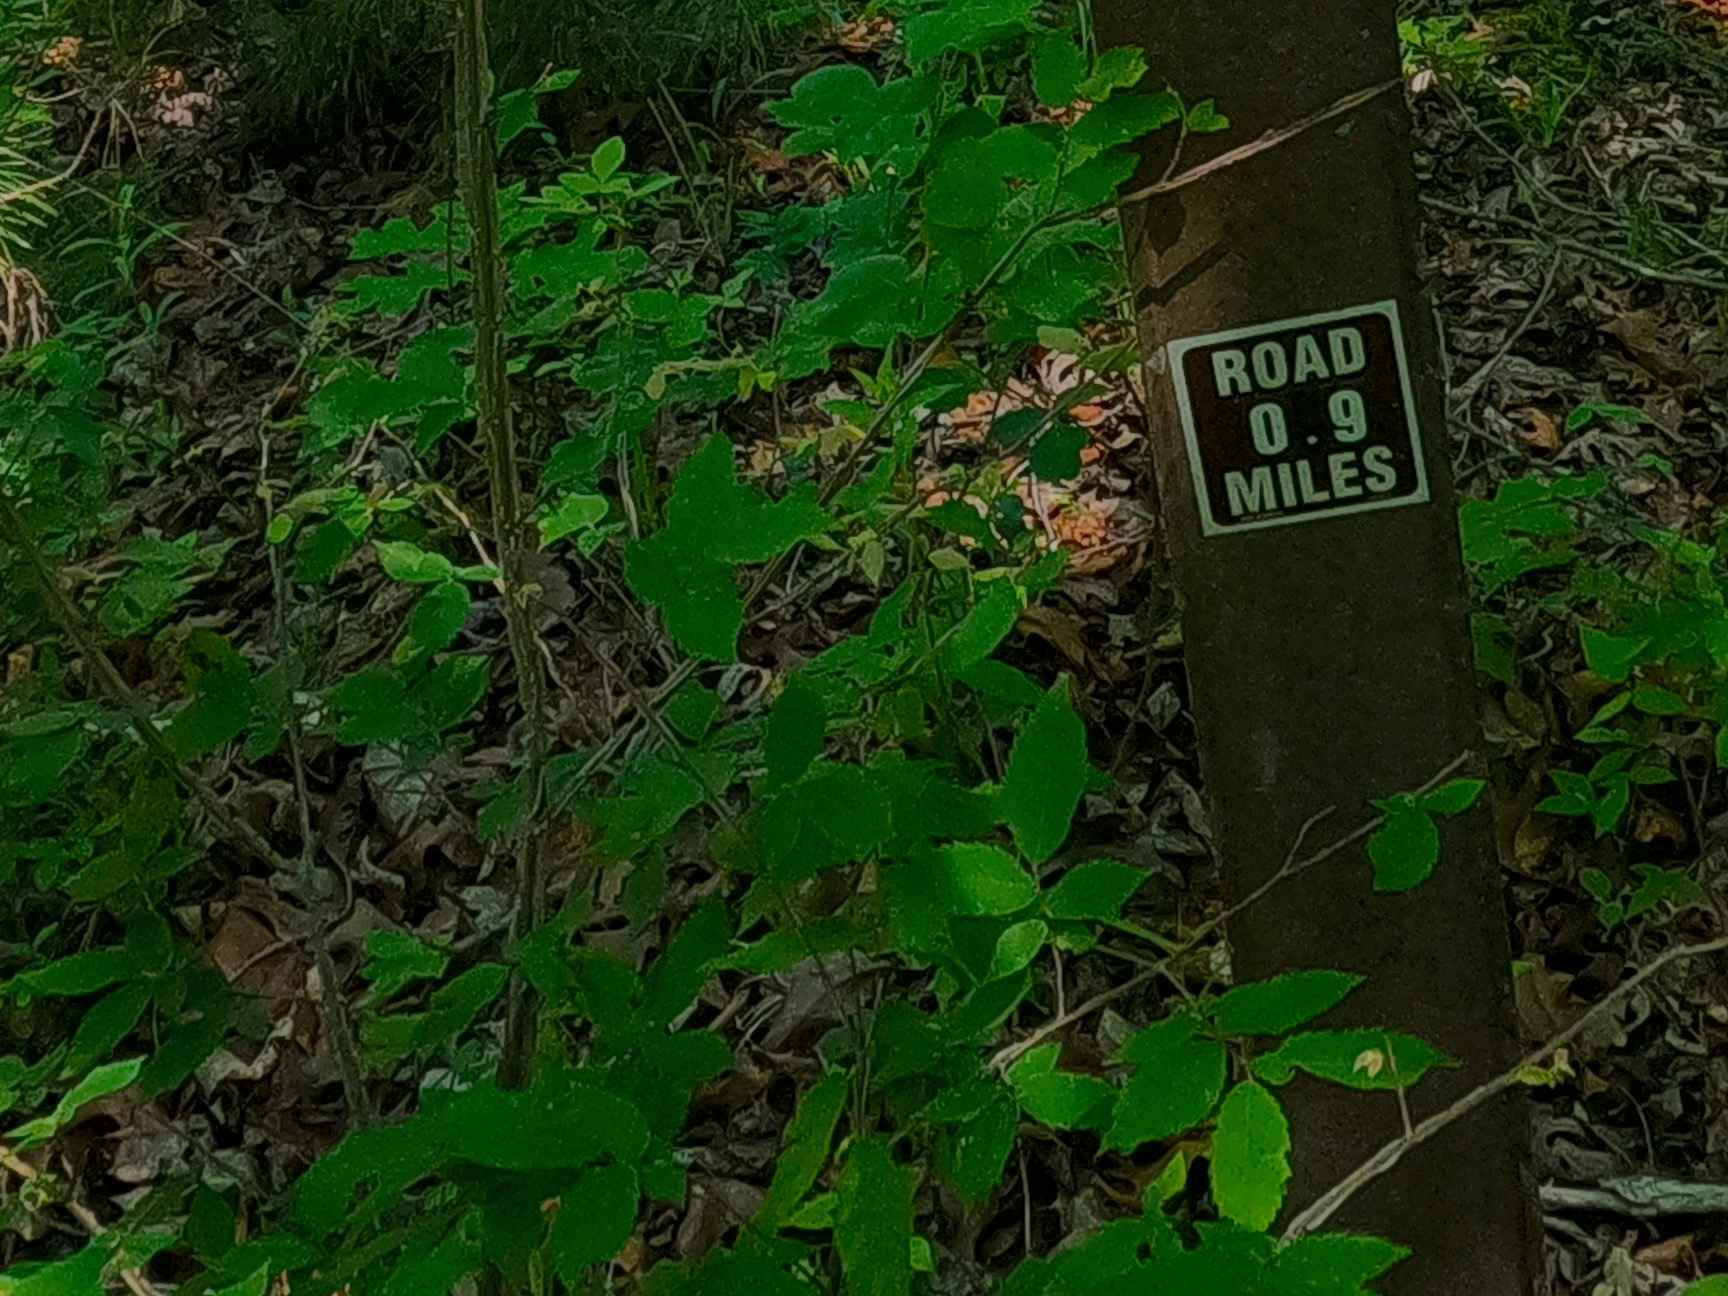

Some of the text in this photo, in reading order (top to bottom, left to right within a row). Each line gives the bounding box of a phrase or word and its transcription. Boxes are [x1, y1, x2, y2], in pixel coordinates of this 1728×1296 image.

[1211, 326, 1366, 397] ROAD
[1248, 389, 1368, 456] 0.9
[1223, 445, 1397, 517] MILES
